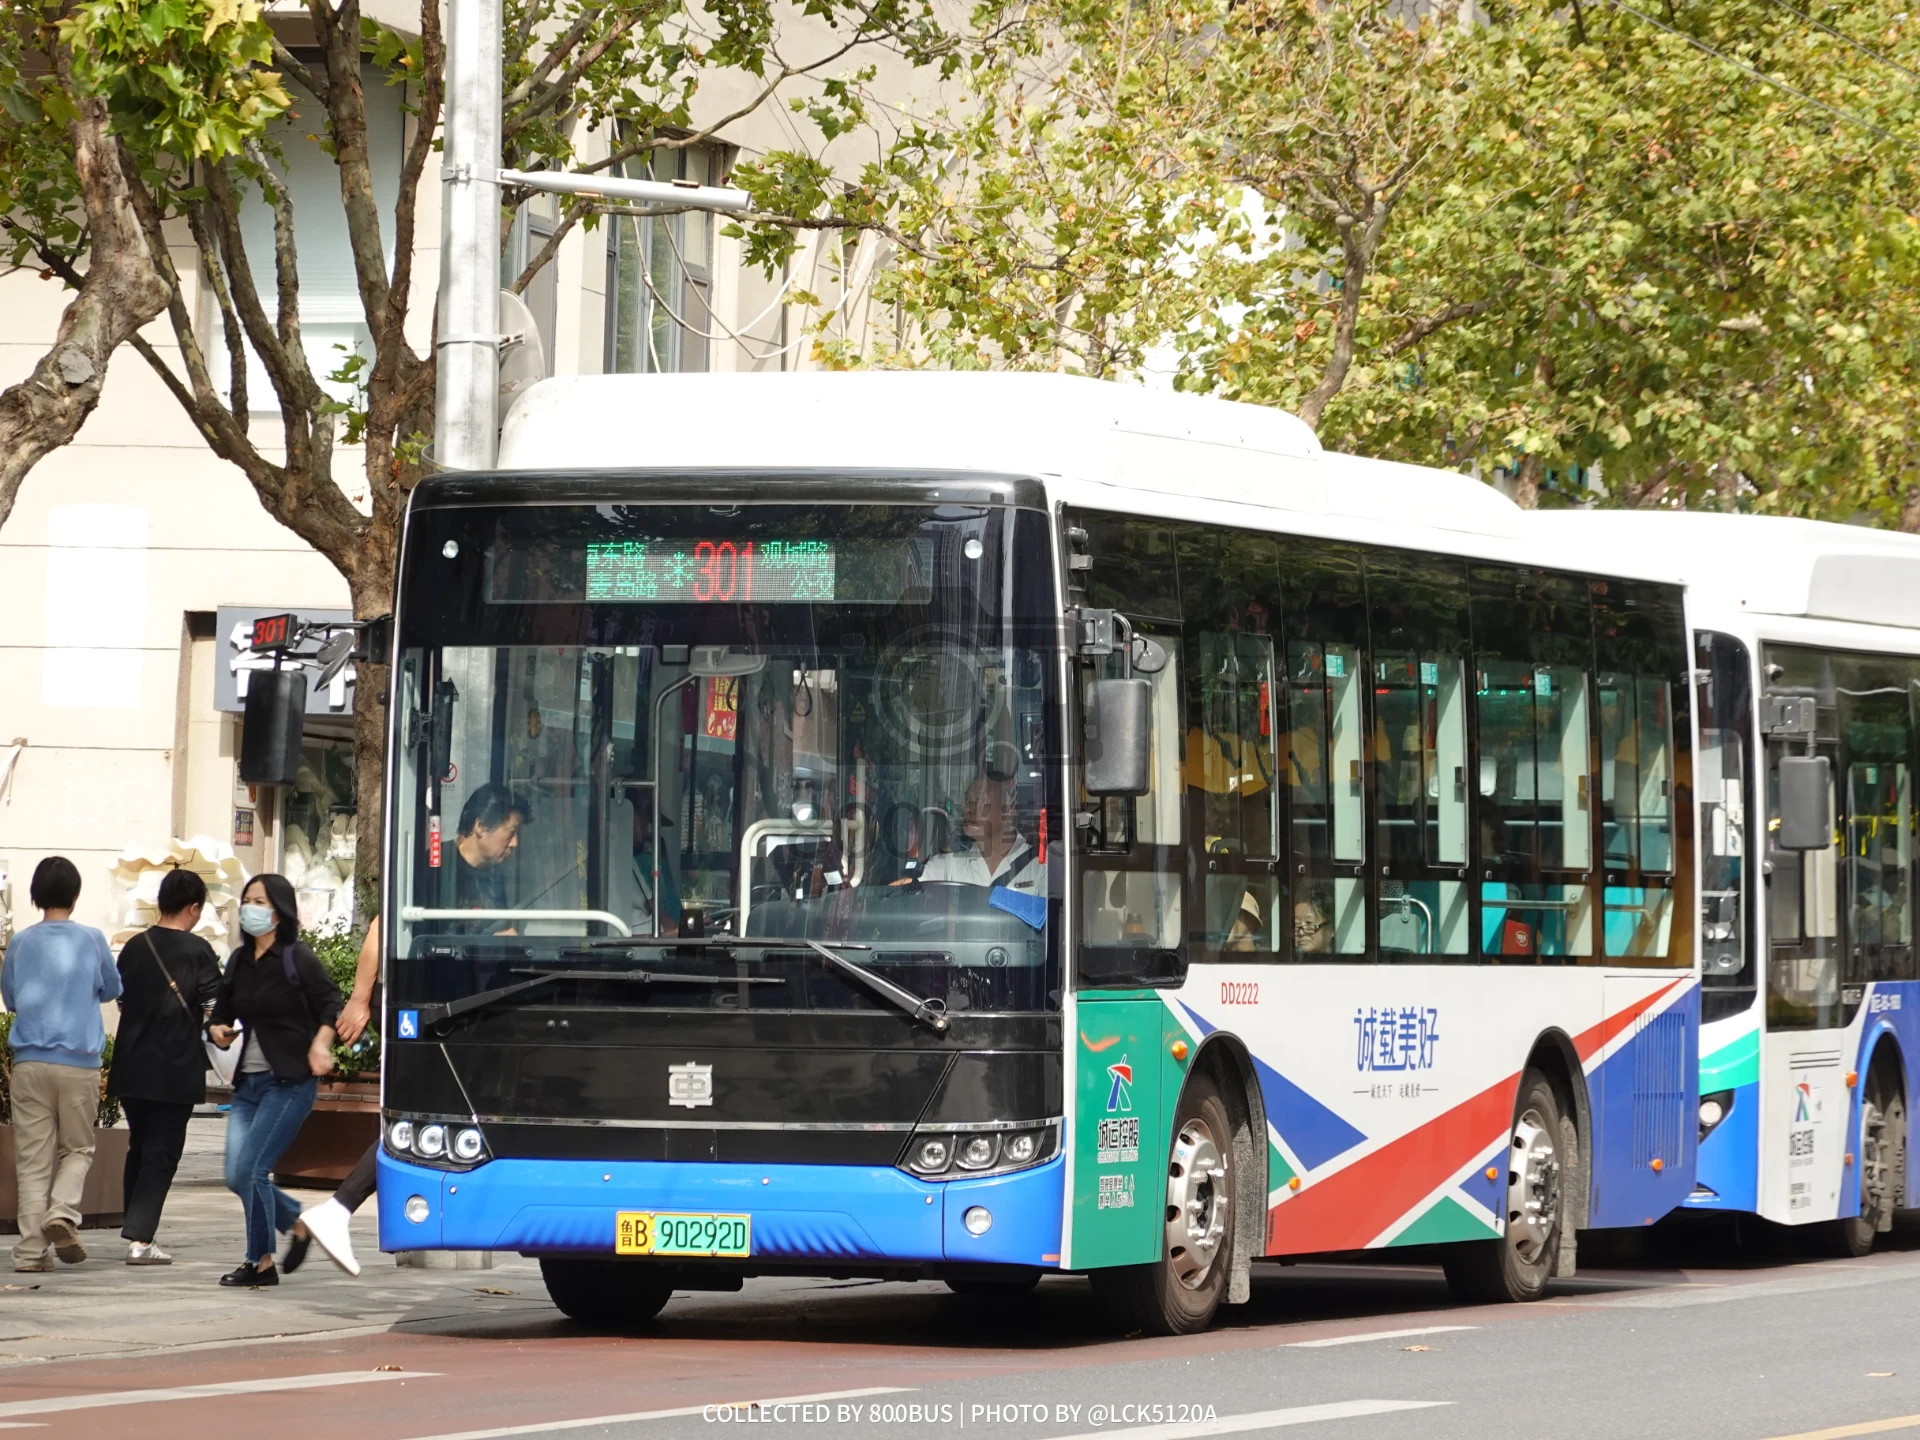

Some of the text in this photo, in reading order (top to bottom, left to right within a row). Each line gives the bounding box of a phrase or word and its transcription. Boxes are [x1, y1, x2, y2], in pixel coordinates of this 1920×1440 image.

[589, 571, 659, 598] 麦岛路
[693, 541, 753, 601] 301
[253, 617, 287, 645] 301
[1220, 982, 1260, 1005] DD2222
[1353, 1006, 1440, 1072] 诚载美好
[1098, 1118, 1138, 1150] 城运控股
[620, 1219, 746, 1249] 鲁B 90292D
